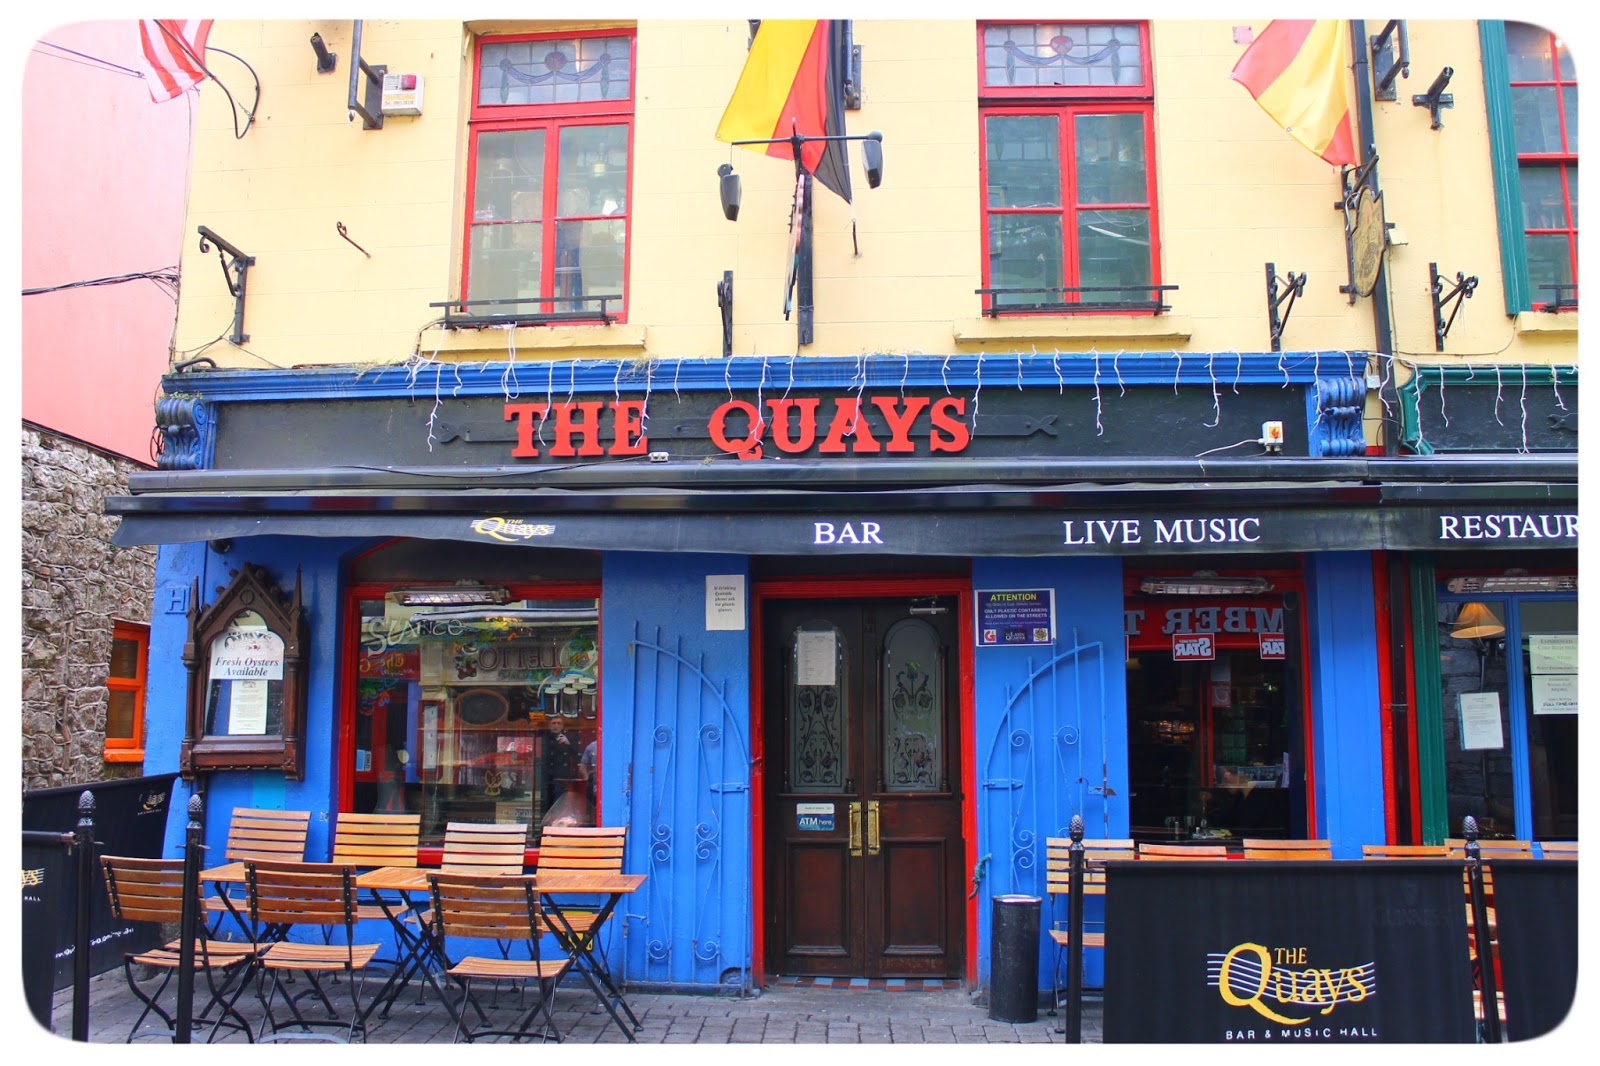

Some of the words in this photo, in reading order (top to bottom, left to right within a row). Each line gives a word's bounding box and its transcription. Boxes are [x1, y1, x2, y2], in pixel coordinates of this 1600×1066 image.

[504, 400, 648, 458] THE
[706, 396, 970, 460] QUAYS
[474, 516, 550, 542] Quays
[813, 521, 884, 546] BAR
[1062, 518, 1142, 545] LIVE
[1153, 517, 1261, 545] MUSIC
[1439, 514, 1578, 541] RESTAUR
[990, 593, 1037, 602] ATTENTION
[215, 657, 242, 667] Fresh
[244, 657, 280, 669] Oysters
[224, 666, 268, 677] Available
[799, 817, 818, 826] ATM
[818, 818, 832, 826] here
[1274, 947, 1307, 965] THE
[1219, 942, 1367, 1025] Quays
[1225, 1029, 1256, 1040] BAR
[1264, 1029, 1271, 1039] &
[1281, 1028, 1331, 1038] MUSIC
[1340, 1026, 1378, 1037] HALL
